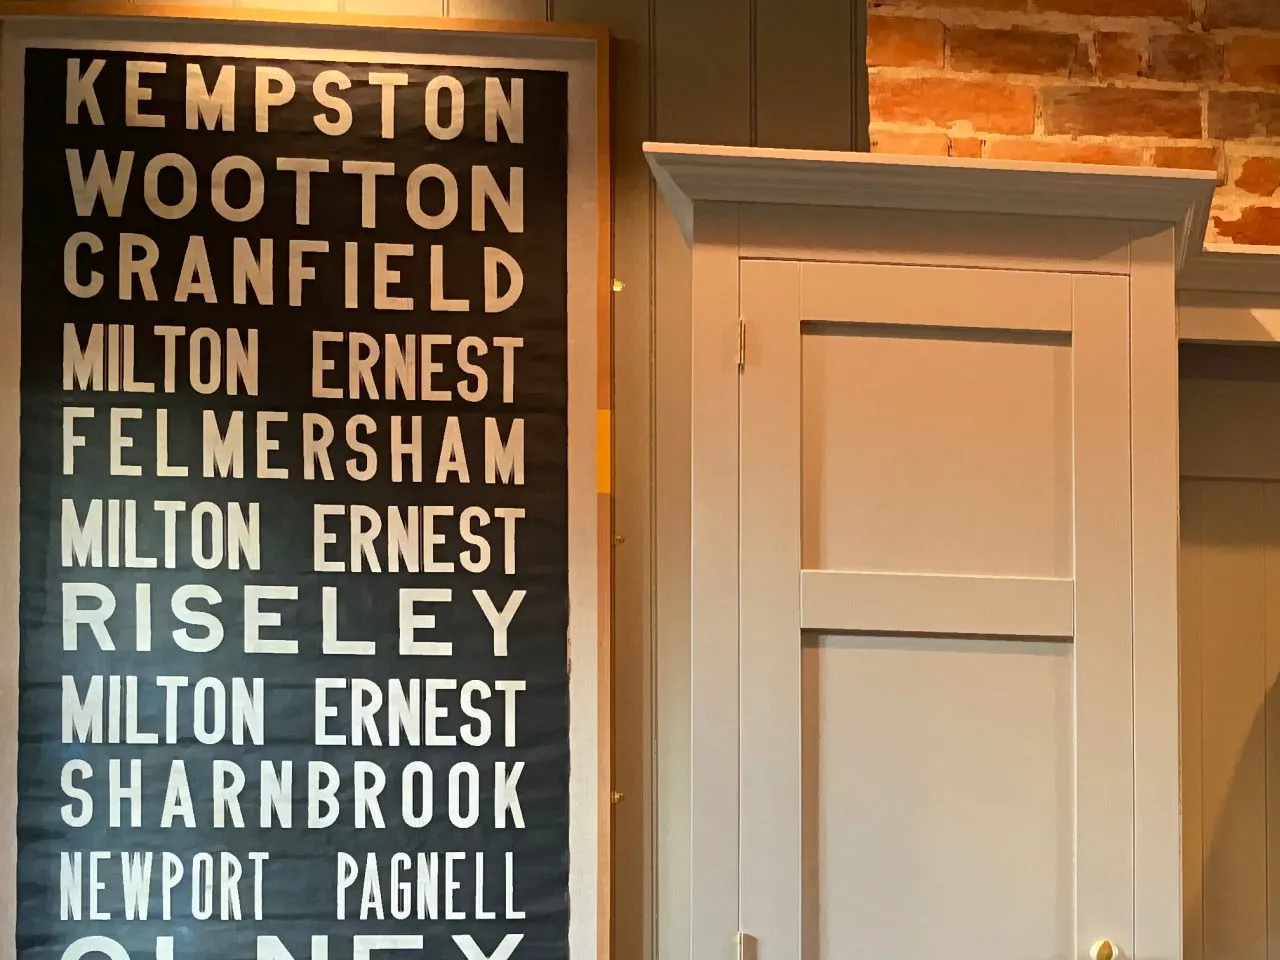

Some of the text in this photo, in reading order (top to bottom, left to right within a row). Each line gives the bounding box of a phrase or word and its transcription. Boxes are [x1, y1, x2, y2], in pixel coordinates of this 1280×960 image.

[65, 58, 525, 144] KEMPSTON
[65, 148, 525, 233] WOOTTON
[63, 231, 525, 313] CRANFIELD
[62, 322, 524, 403] MILTON ERNEST
[62, 406, 525, 485] FELMERSHAM
[60, 498, 526, 575] MILTON ERNEST
[61, 582, 528, 657] RISELEY
[61, 675, 527, 748] MILTON ERNEST
[60, 758, 526, 829] SHARNBROOK
[59, 851, 527, 921] NEWPORT PAGNELL
